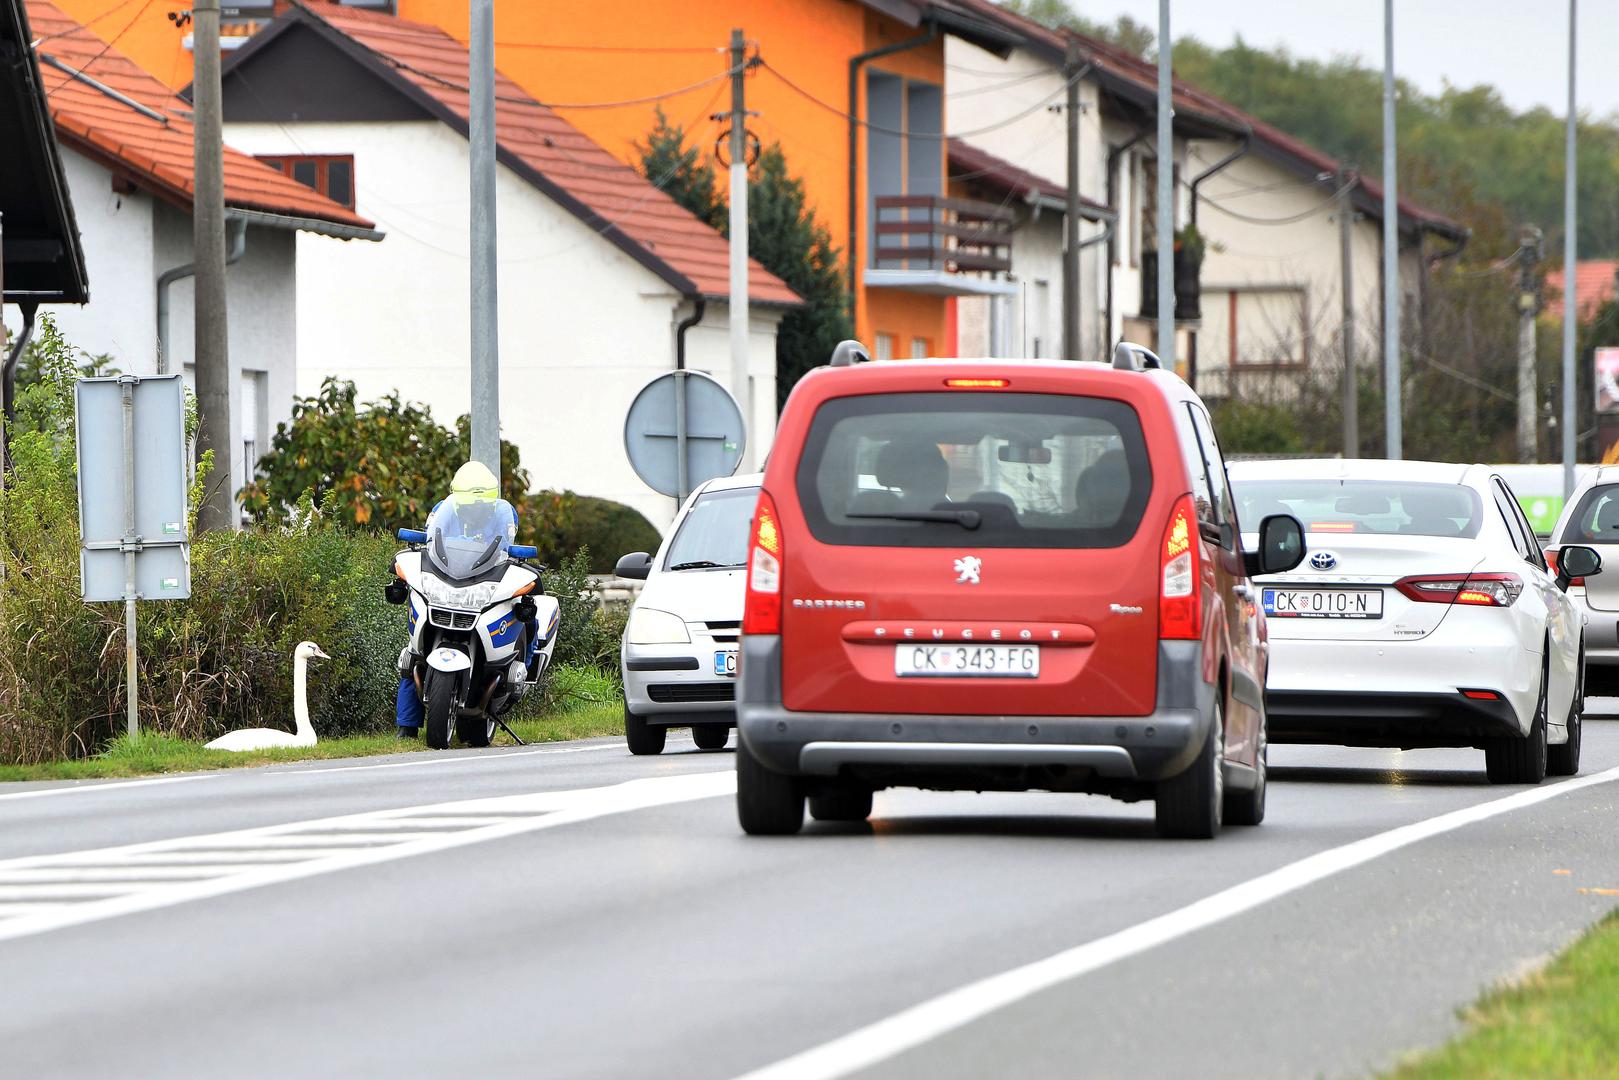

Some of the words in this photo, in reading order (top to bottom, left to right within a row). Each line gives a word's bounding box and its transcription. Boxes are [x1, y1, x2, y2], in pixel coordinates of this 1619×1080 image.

[1312, 593, 1367, 612] 010-N
[874, 626, 1062, 641] PEUGEOT
[955, 647, 1034, 670] 343-FG
